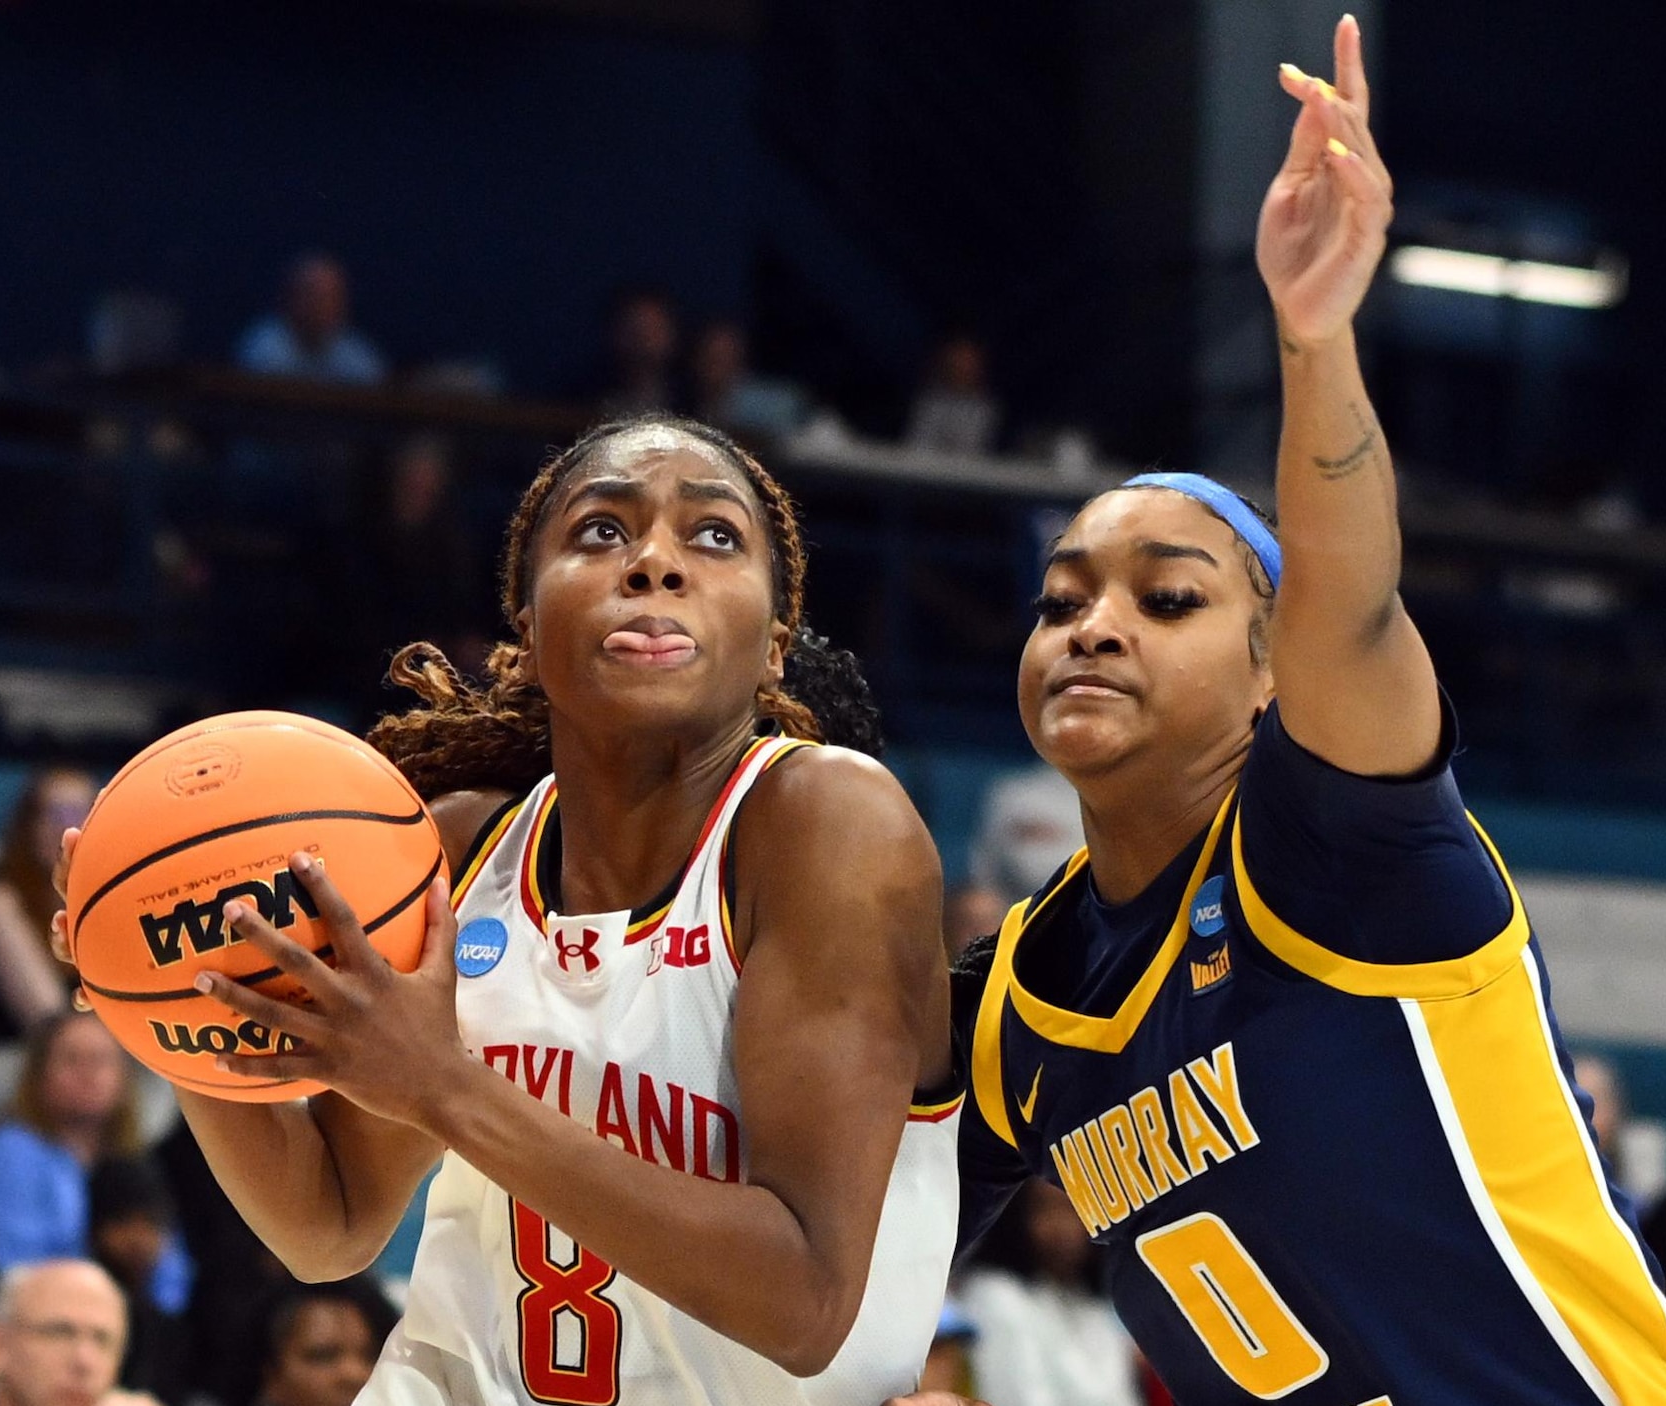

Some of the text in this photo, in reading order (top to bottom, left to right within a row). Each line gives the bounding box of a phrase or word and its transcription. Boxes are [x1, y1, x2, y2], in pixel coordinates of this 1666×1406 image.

[136, 844, 320, 905] OICIAL GAME BALL
[138, 857, 325, 970] NCAA
[457, 943, 501, 961] NCAA
[1049, 1041, 1261, 1239] MURRAY
[1135, 1211, 1330, 1400] 0
